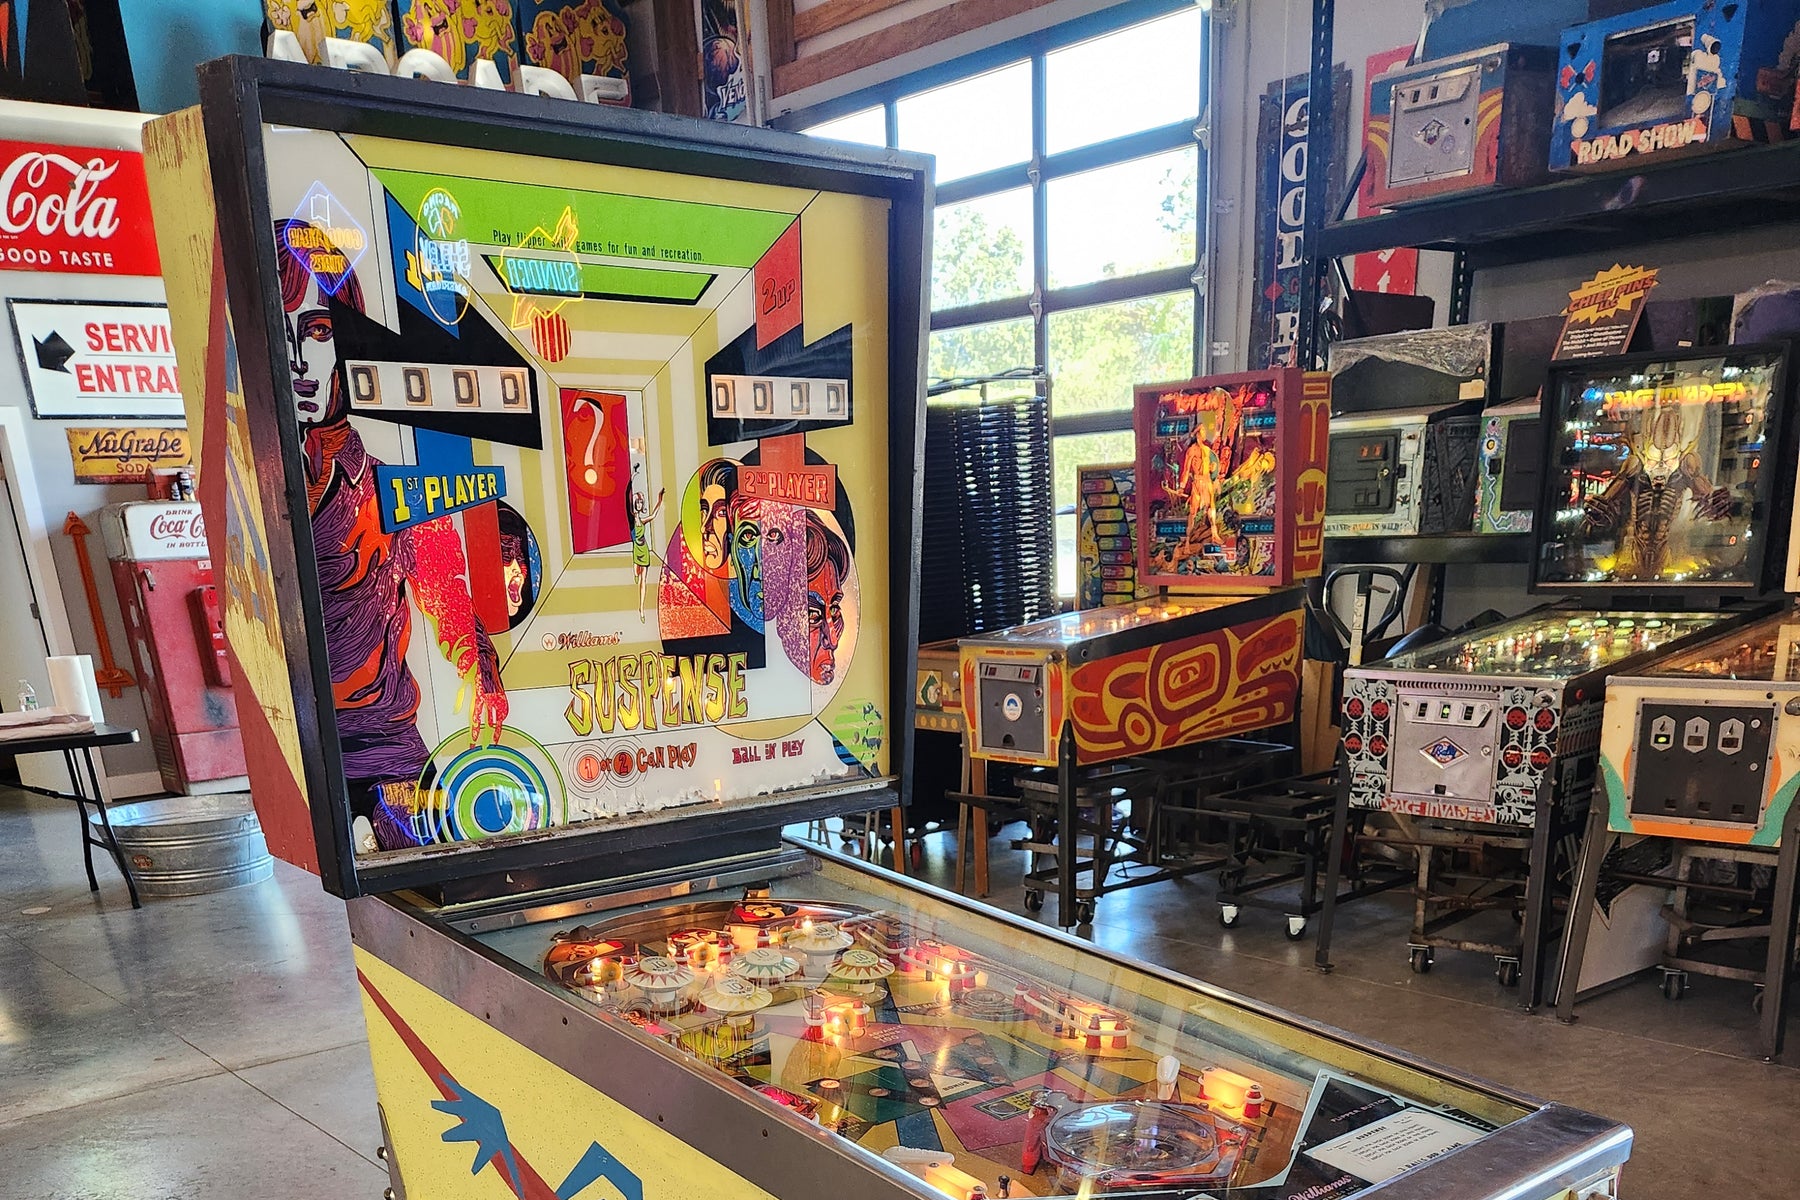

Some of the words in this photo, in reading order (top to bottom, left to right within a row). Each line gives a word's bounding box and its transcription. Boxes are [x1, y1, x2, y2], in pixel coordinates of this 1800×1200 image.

[1578, 134, 1633, 164] ROAD
[1639, 120, 1697, 151] SHOW
[0, 152, 120, 239] Cola
[60, 251, 113, 267] TASTE
[493, 230, 511, 246] Play
[517, 232, 545, 248] flipper
[576, 240, 602, 255] games
[608, 242, 619, 253] for
[624, 243, 638, 255] fun
[642, 245, 655, 257] and
[661, 247, 705, 262] recreation.
[1568, 288, 1612, 313] CHIEF
[1615, 275, 1655, 298] PINS
[1596, 298, 1619, 313] LLC
[85, 322, 170, 353] SERVI
[75, 364, 182, 393] ENTRA
[79, 430, 182, 462] NuGrape
[424, 473, 498, 515] PLAYER
[768, 472, 829, 503] PLAYER
[558, 631, 621, 651] Williams
[564, 650, 748, 737] SUSPENSE
[585, 758, 594, 780] 1
[600, 758, 611, 773] or
[618, 751, 629, 775] 2
[651, 959, 668, 969] 10
[752, 949, 771, 959] 10
[727, 982, 744, 992] 10
[942, 1080, 970, 1092] BONUS
